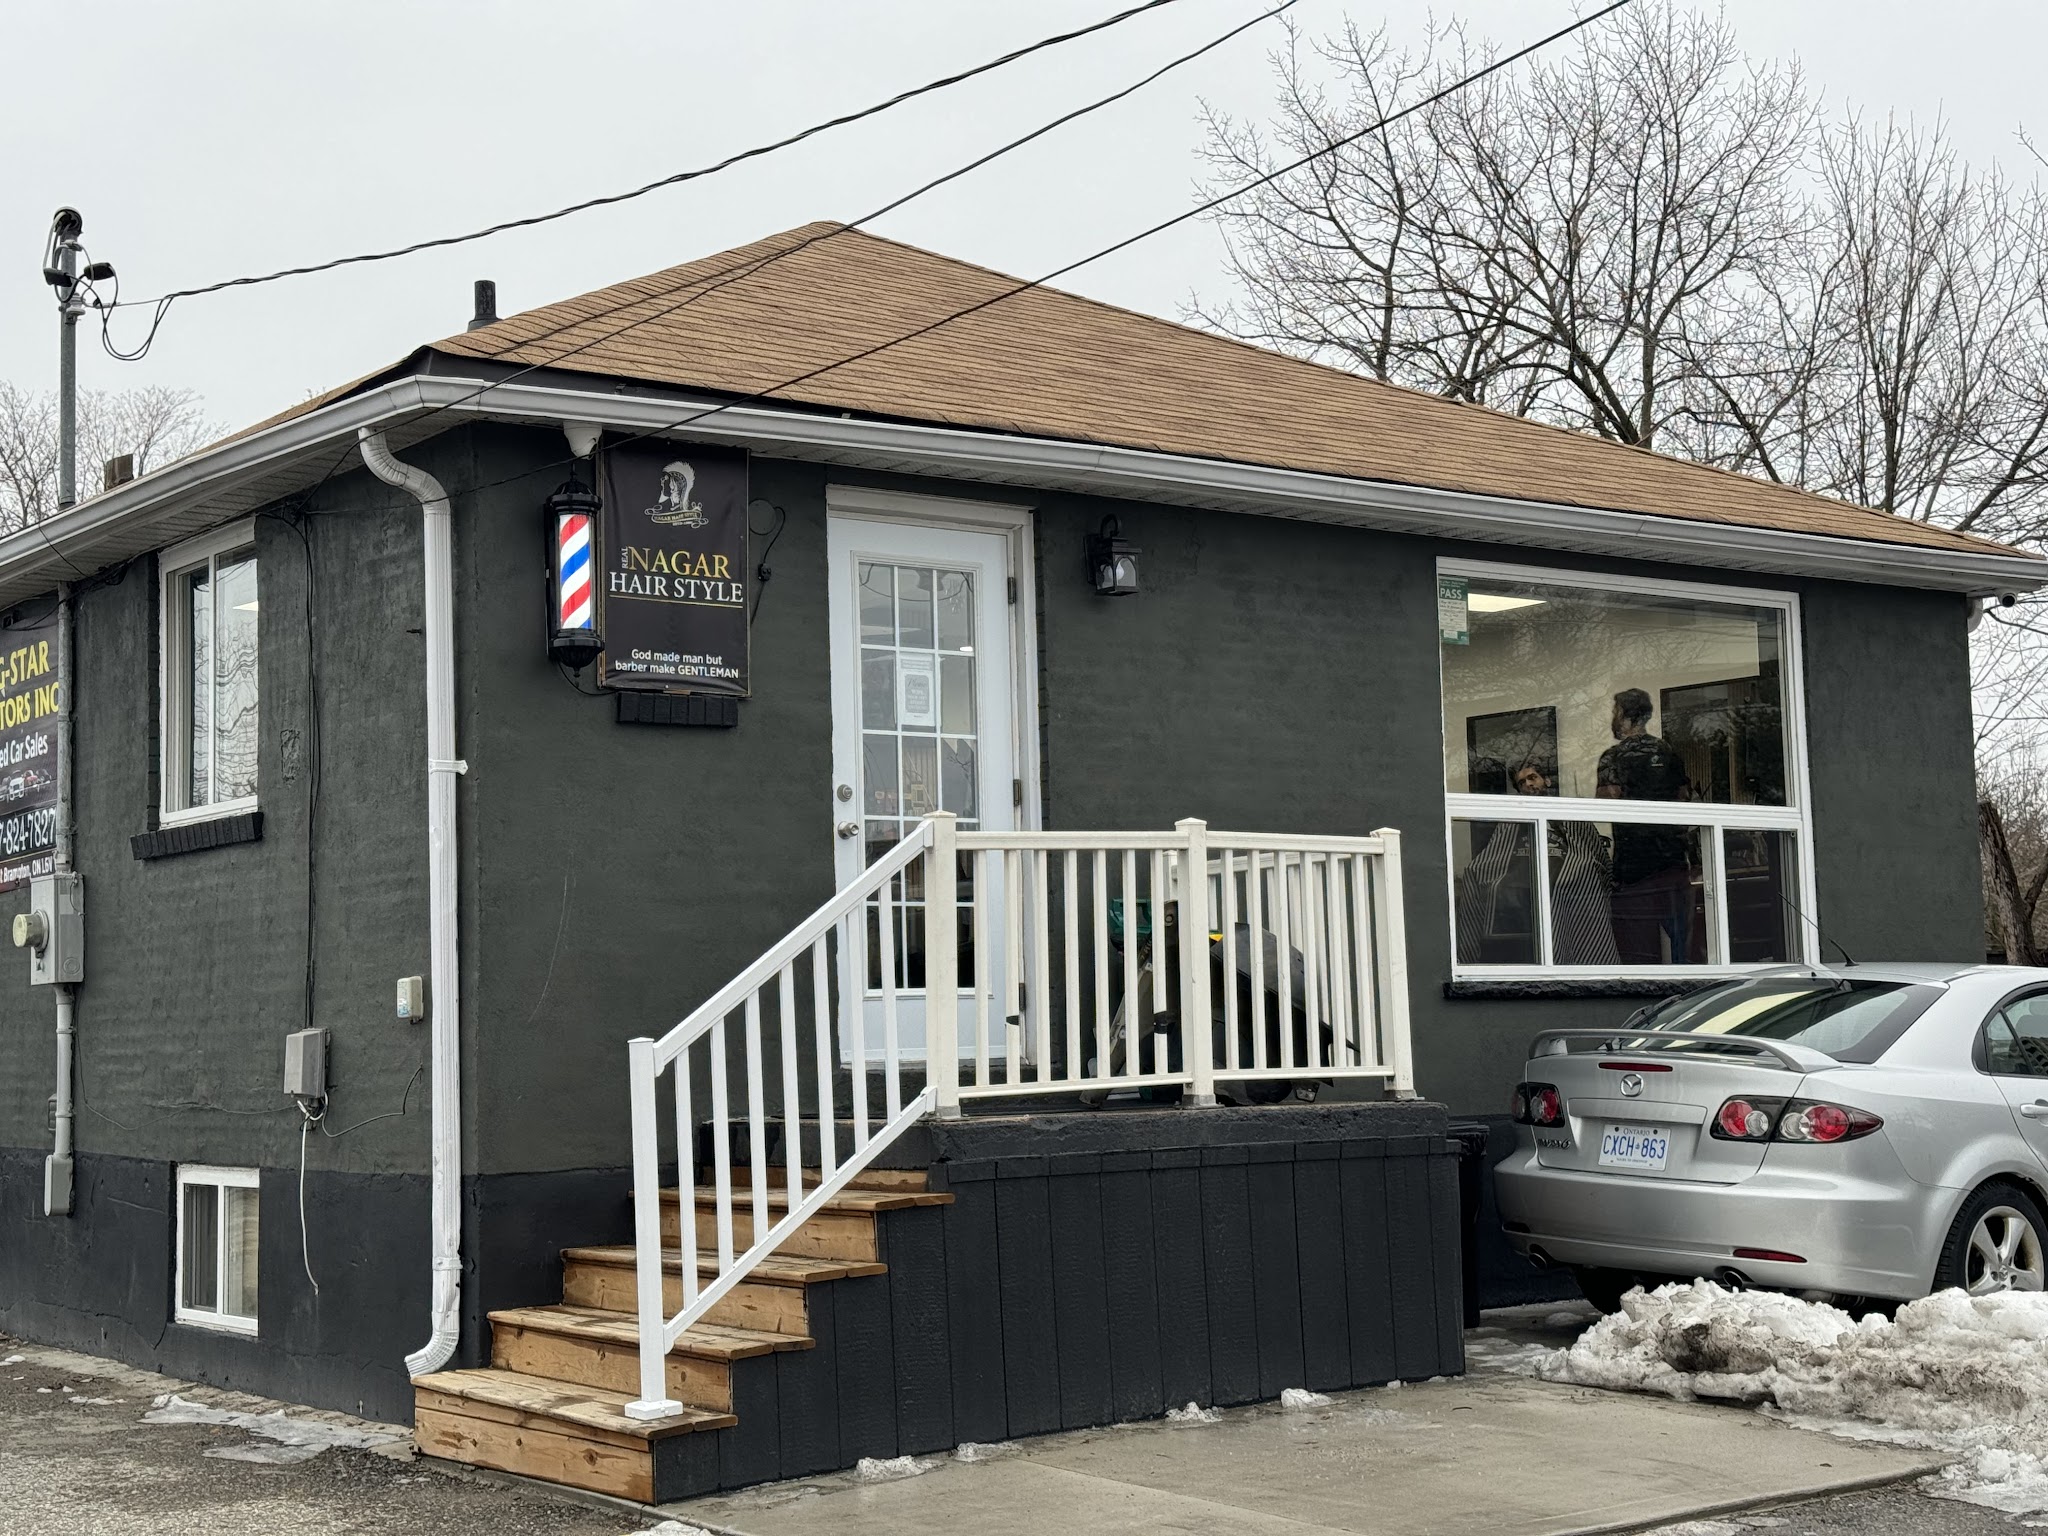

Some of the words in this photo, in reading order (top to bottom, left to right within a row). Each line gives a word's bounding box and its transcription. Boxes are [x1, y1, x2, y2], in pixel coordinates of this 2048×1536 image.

[628, 546, 731, 579] NAGAR
[609, 571, 669, 597] HAIR
[673, 578, 744, 603] STYLE
[1440, 588, 1462, 600] PASS
[615, 660, 647, 672] barber
[649, 664, 676, 675] make
[677, 665, 739, 679] GENTLEMAN
[631, 649, 652, 660] God
[653, 651, 681, 663] made
[682, 655, 704, 664] man
[706, 654, 723, 666] but
[34, 681, 59, 719] INC
[10, 740, 25, 765] Car
[25, 731, 49, 760] Sales
[32, 858, 41, 876] ON
[1603, 1135, 1636, 1156] CXCH
[1641, 1138, 1666, 1159] 863
